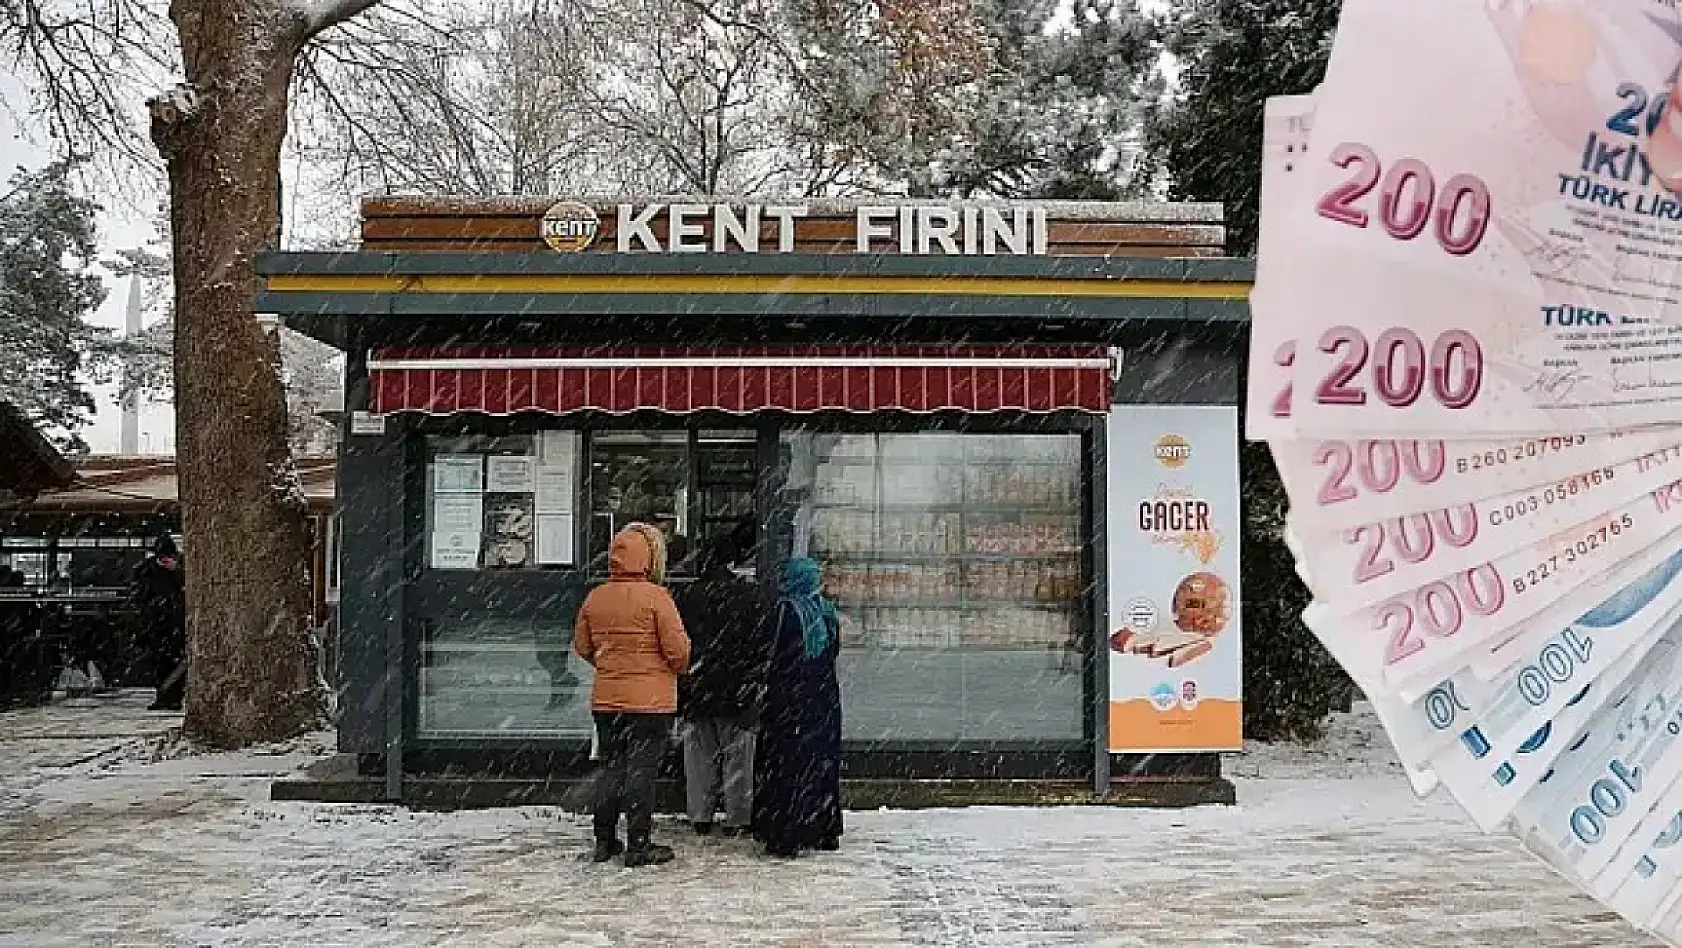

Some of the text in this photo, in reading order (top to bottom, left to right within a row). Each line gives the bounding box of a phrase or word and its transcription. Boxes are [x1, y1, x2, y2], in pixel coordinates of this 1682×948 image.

[617, 203, 1047, 254] KENT FIRINI
[1315, 142, 1491, 255] 200
[1314, 325, 1484, 409] 200
[1312, 440, 1446, 506] 200
[1456, 448, 1507, 474] B260
[1138, 501, 1210, 531] GACER
[1348, 502, 1480, 584] 200
[1371, 562, 1505, 666] 200
[1565, 513, 1633, 562] 302765
[1518, 627, 1593, 706] 100
[1569, 759, 1644, 844] 100
